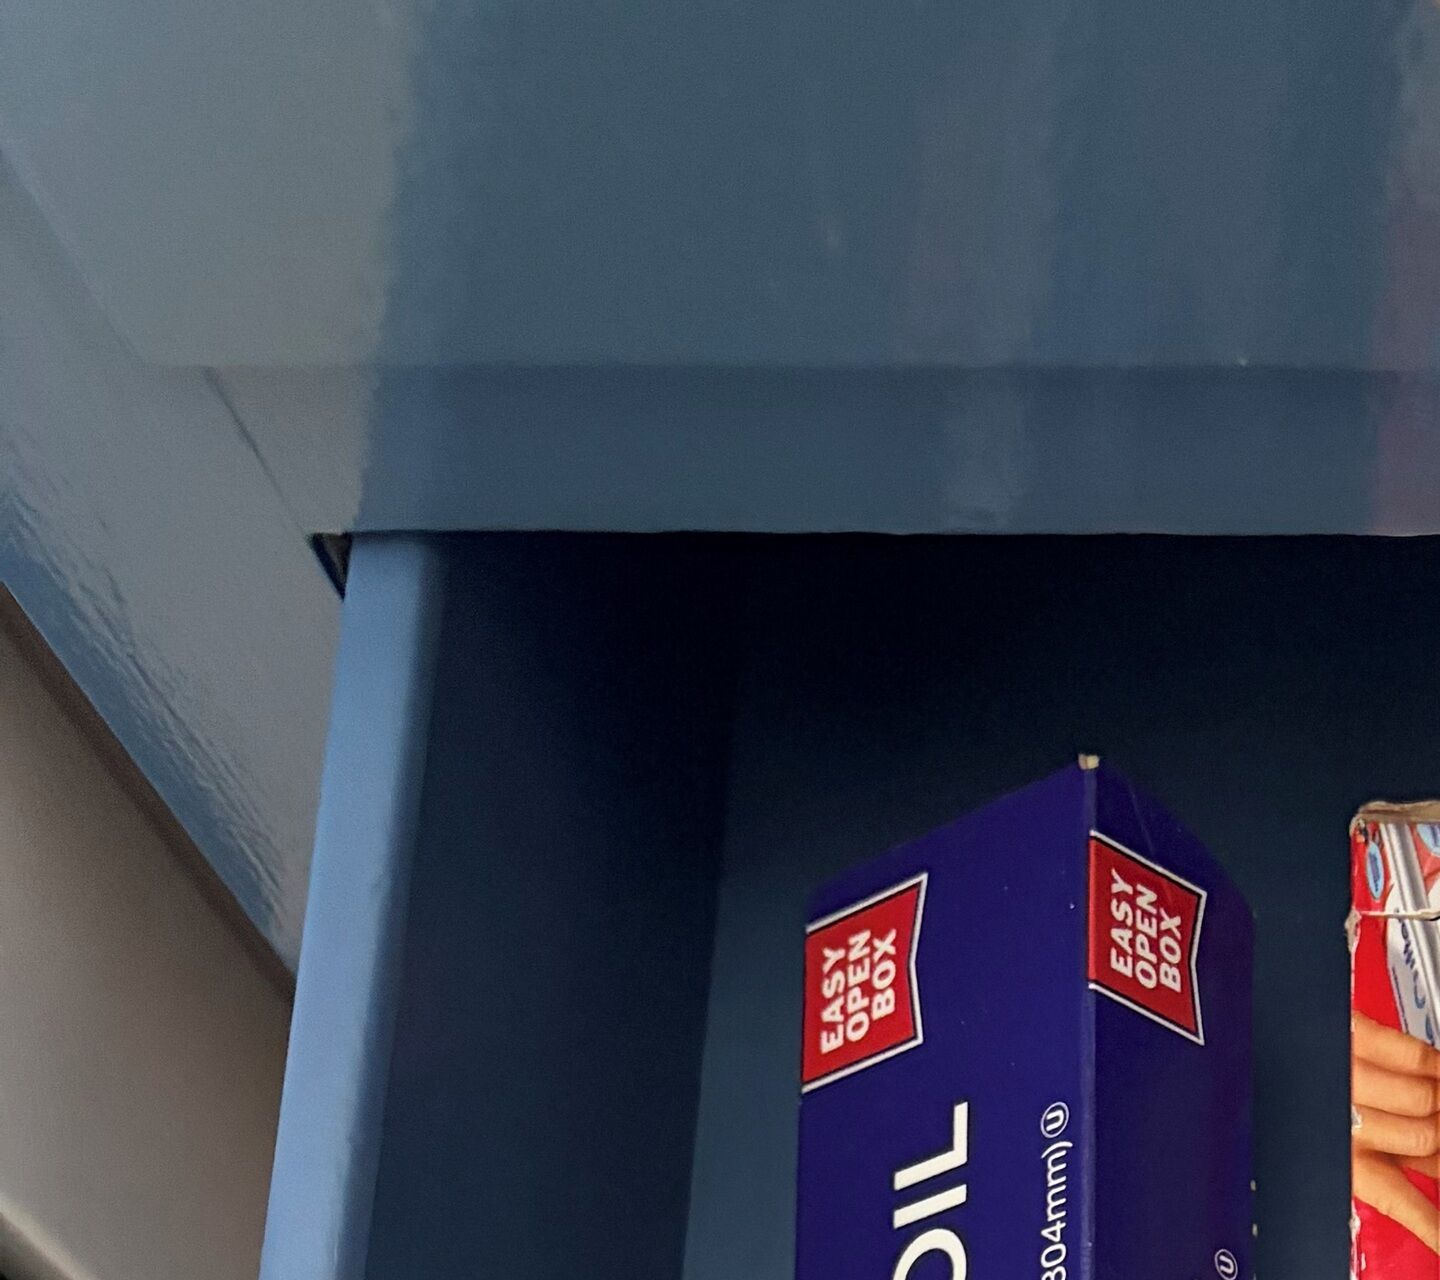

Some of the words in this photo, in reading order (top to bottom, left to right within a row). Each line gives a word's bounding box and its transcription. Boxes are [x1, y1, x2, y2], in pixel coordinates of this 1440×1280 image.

[872, 929, 896, 1020] BOX
[1111, 868, 1132, 977] EASY
[1135, 883, 1157, 989] OPEN
[1160, 908, 1181, 992] BOX
[821, 946, 845, 1053] EASY
[847, 930, 870, 1041] OPEN
